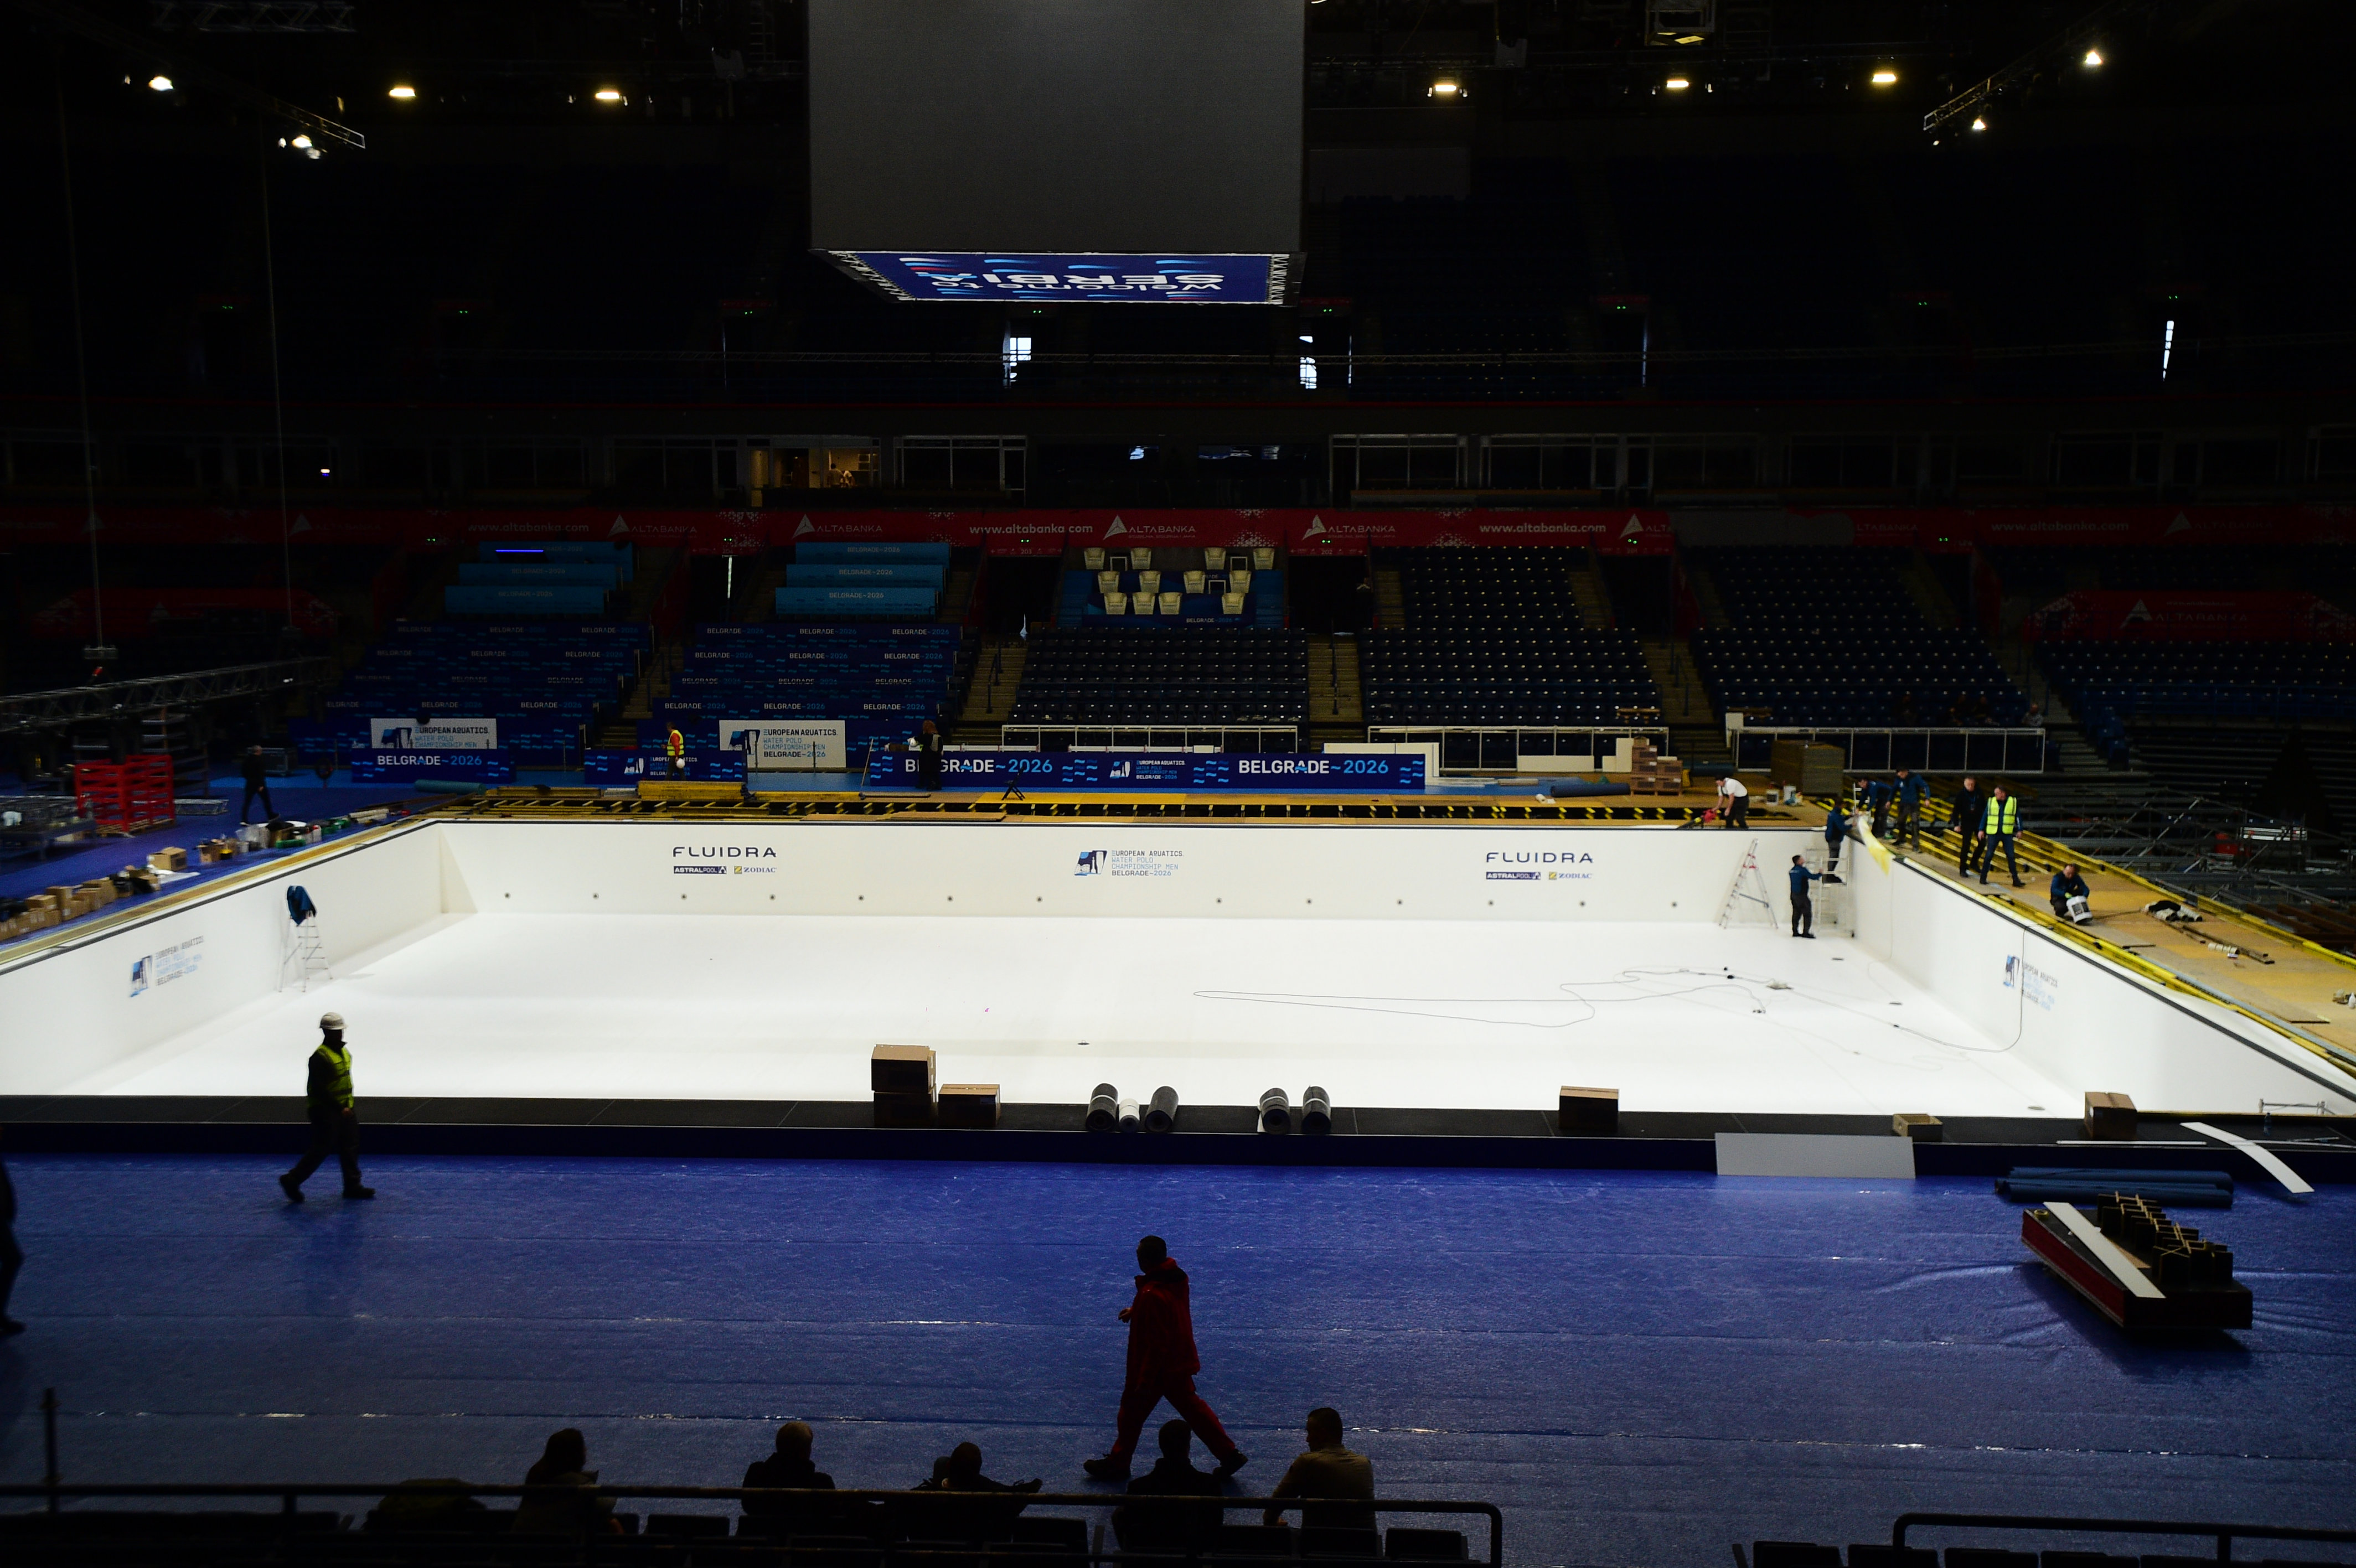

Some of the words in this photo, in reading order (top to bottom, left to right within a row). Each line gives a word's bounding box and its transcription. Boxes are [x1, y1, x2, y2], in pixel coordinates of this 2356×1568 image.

[915, 272, 1224, 284] SERBIA
[817, 525, 883, 533] ALTABANKA
[969, 524, 1093, 534] www.altabankacom
[673, 847, 777, 857] FLUIDRA
[1486, 852, 1593, 863] FLUIDRA
